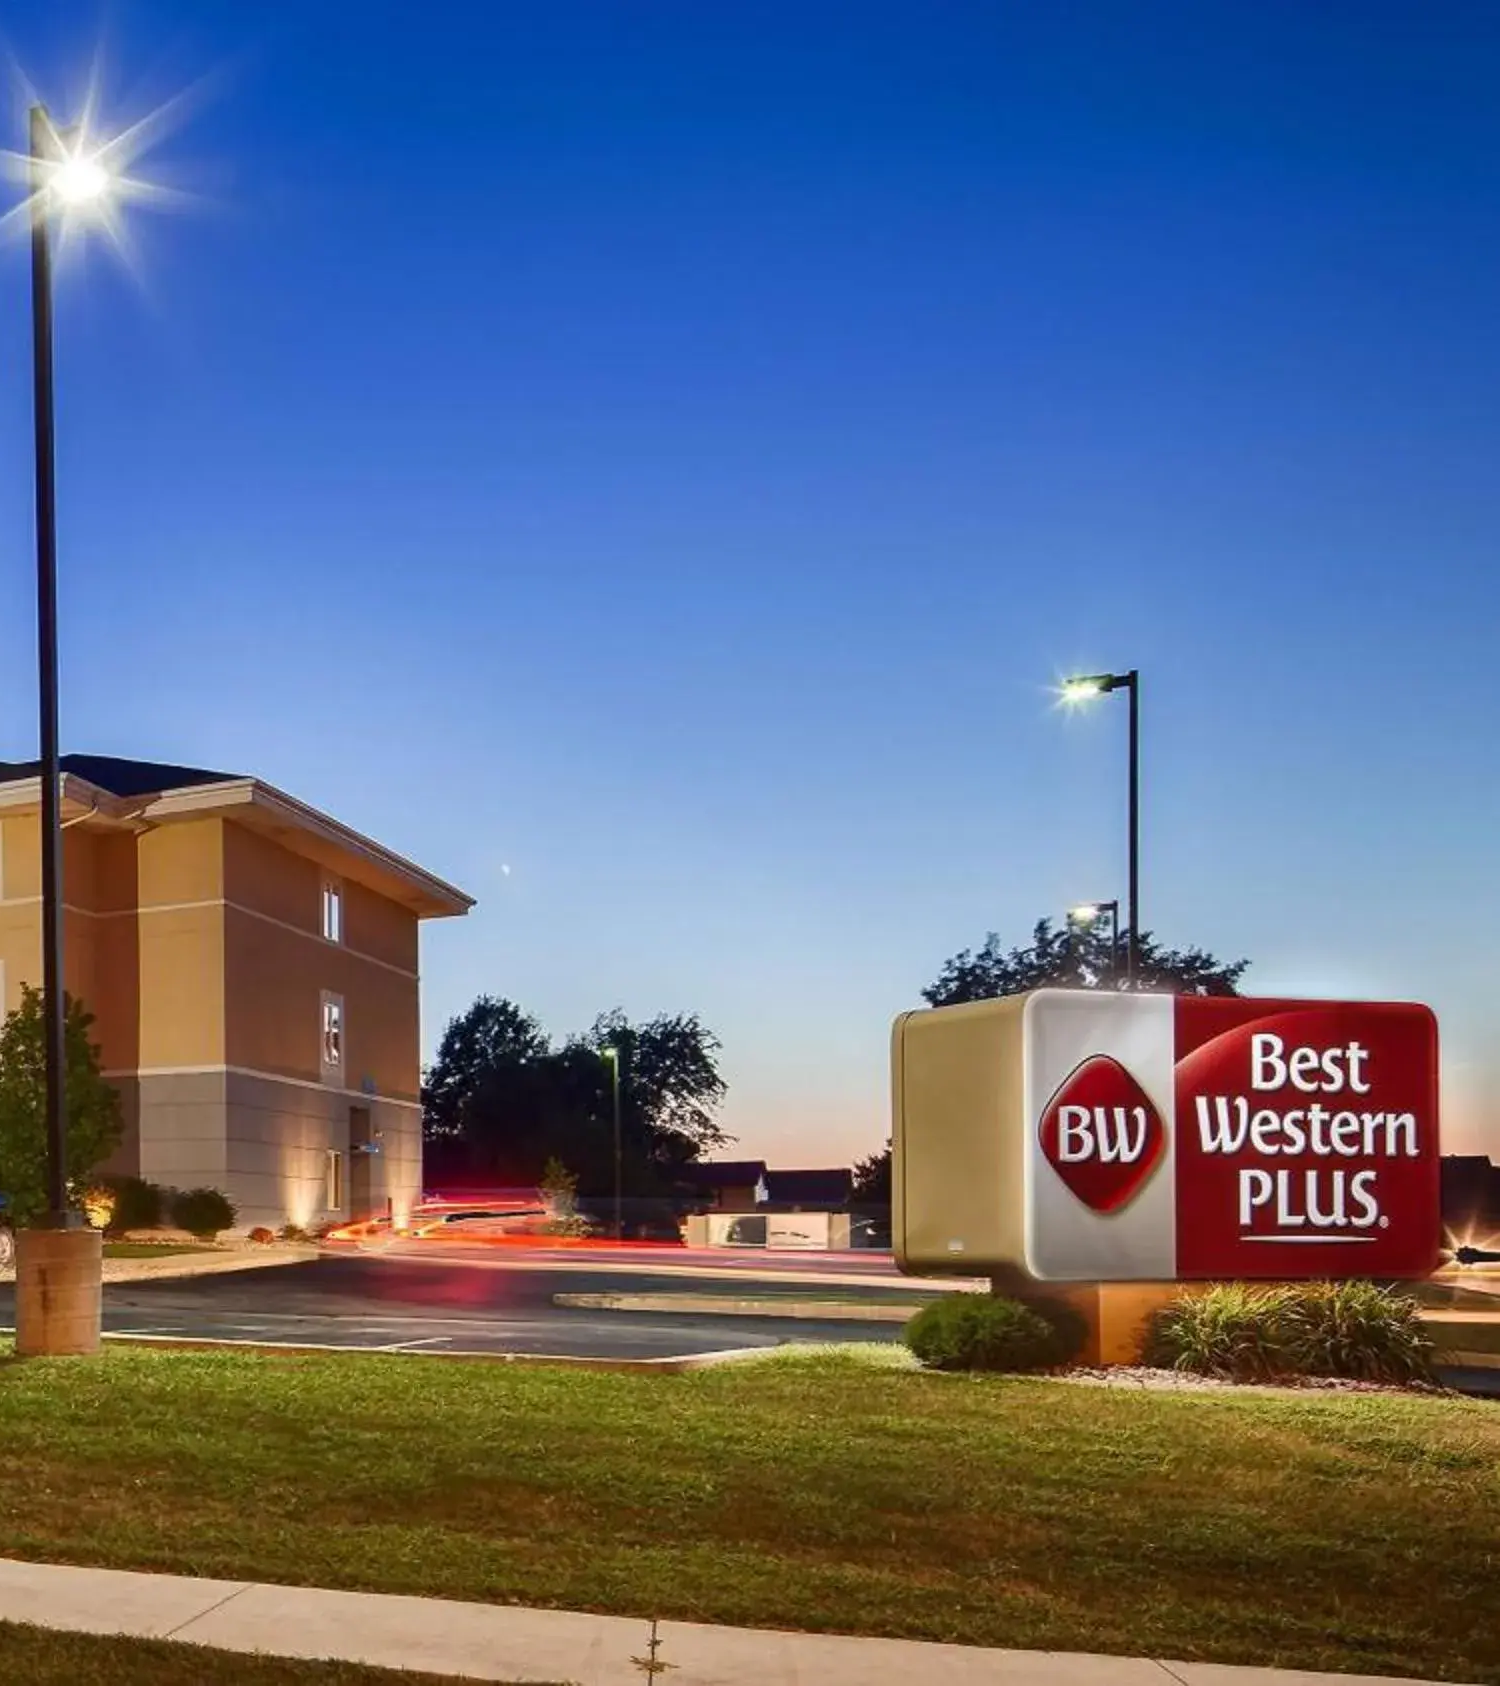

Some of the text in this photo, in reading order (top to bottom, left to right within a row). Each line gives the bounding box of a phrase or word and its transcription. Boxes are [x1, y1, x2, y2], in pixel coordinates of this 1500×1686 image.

[1250, 1032, 1370, 1094] Best
[1057, 1104, 1146, 1164] BW
[1195, 1095, 1419, 1157] Western
[1238, 1168, 1379, 1229] PLUS
